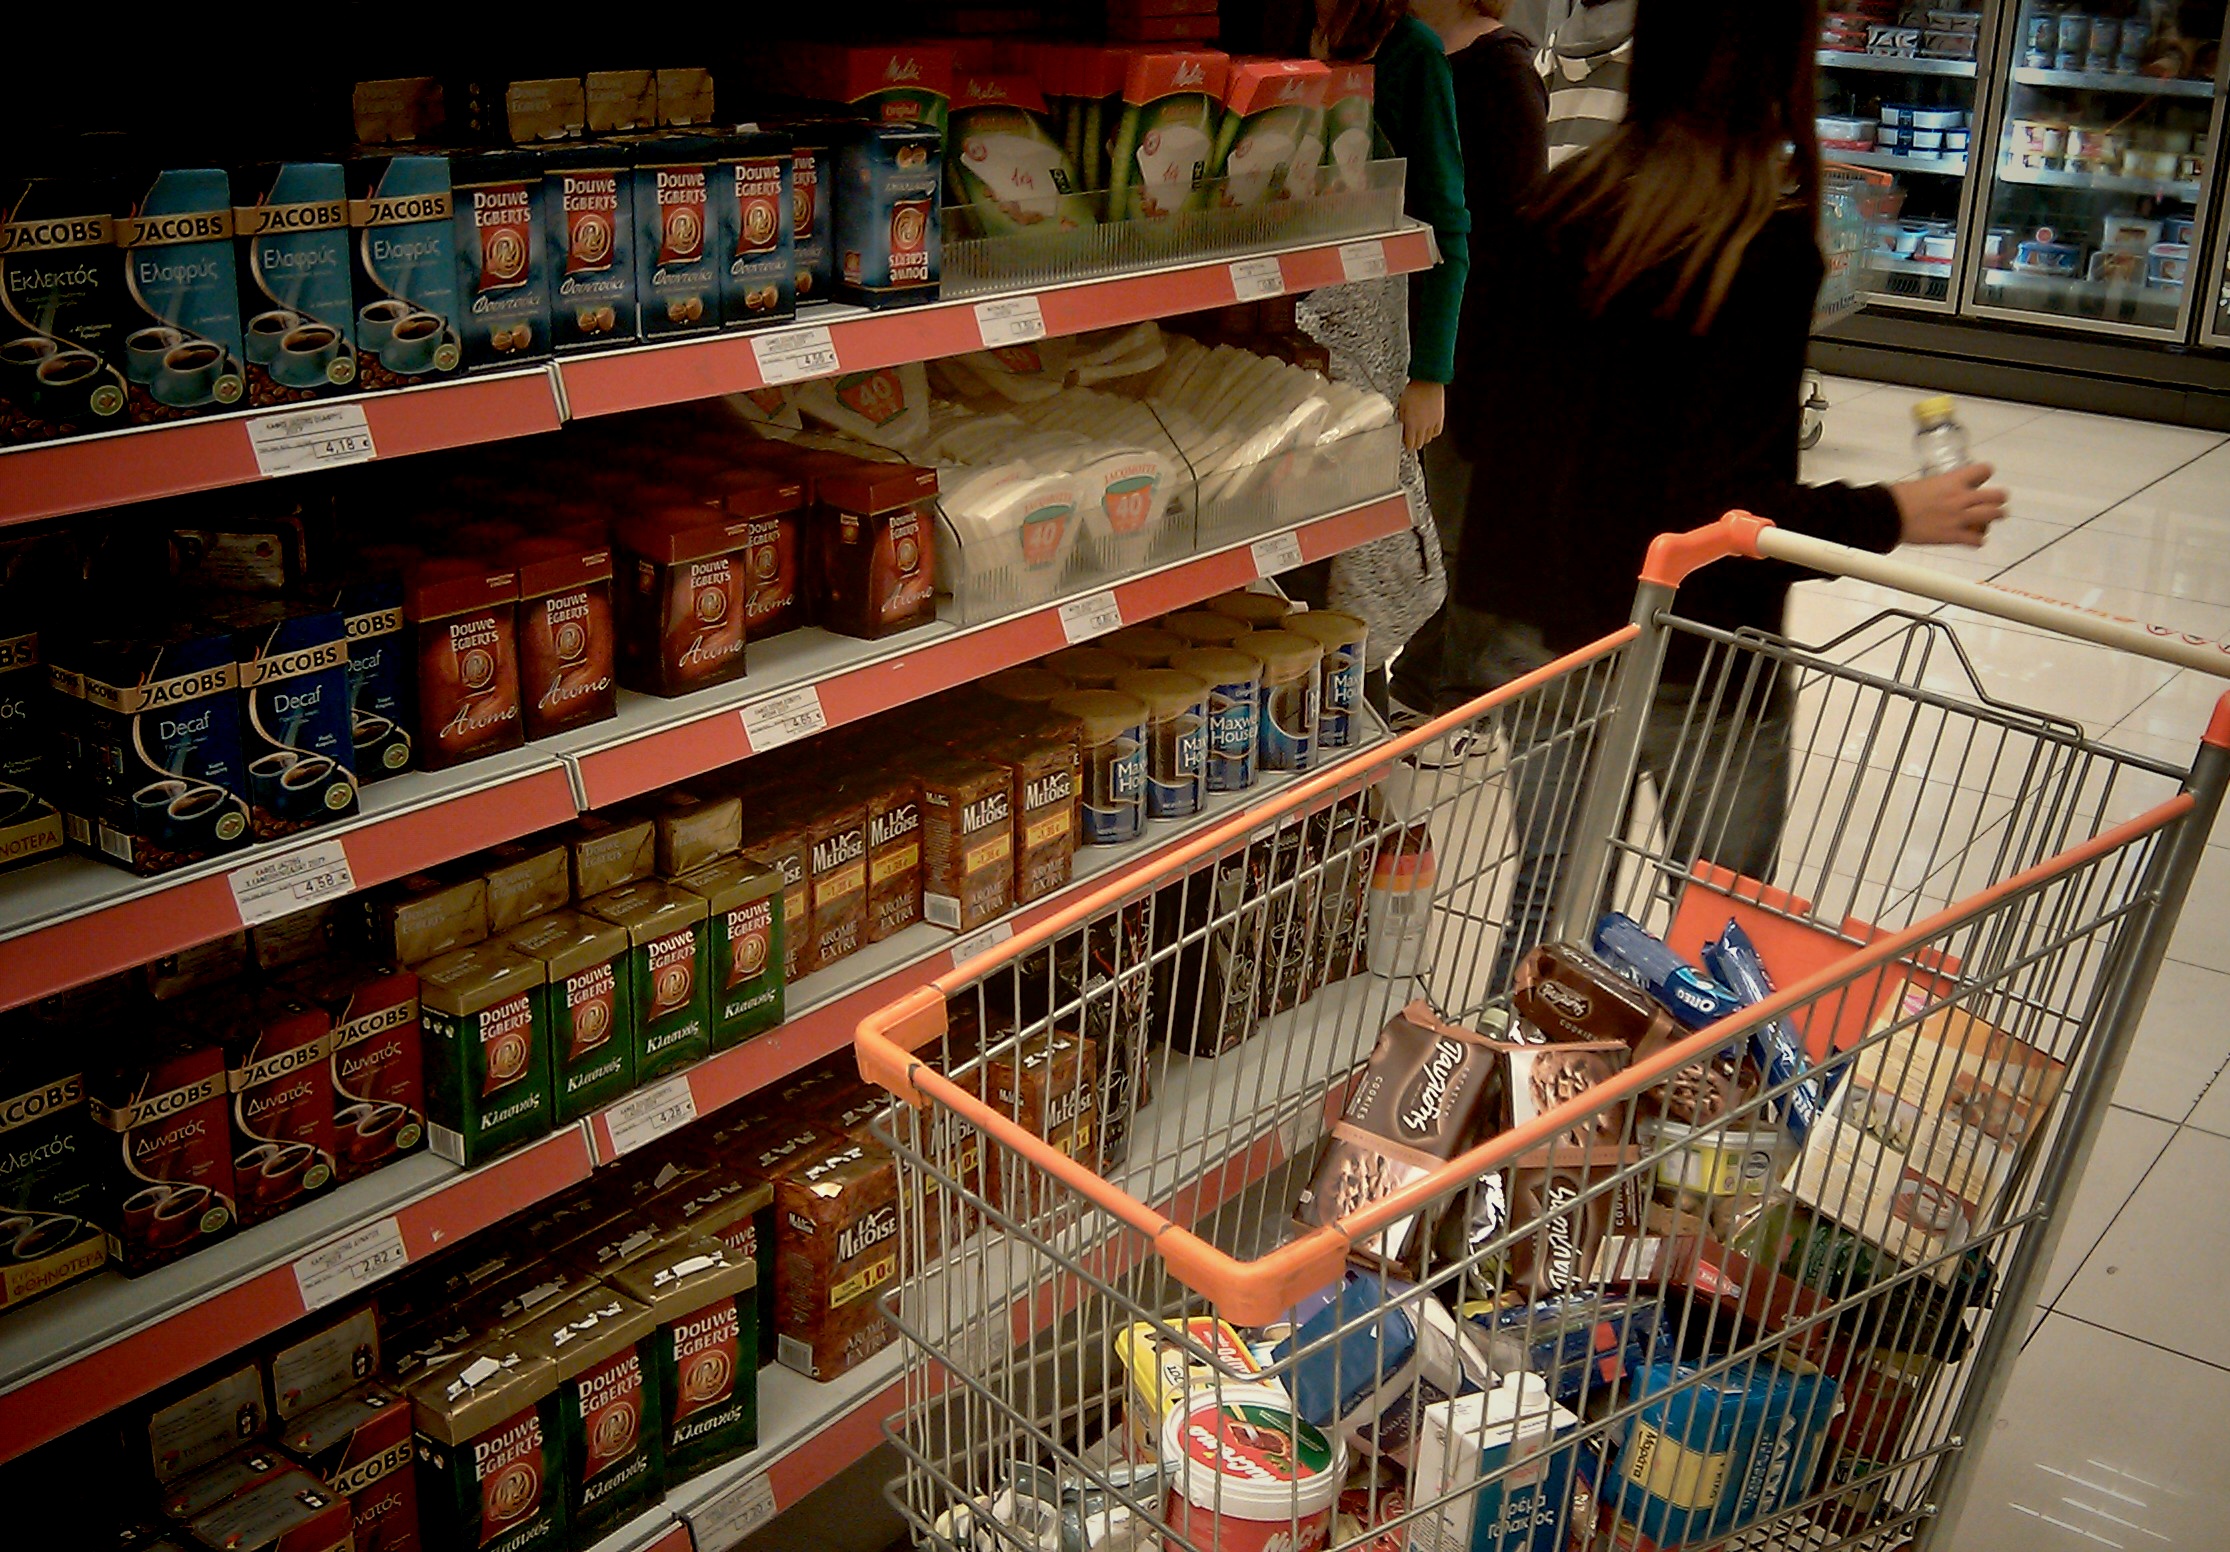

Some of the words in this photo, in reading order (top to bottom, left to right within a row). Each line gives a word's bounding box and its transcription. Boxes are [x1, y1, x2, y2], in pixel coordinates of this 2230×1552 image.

[563, 177, 617, 195] Douwe
[657, 171, 706, 188] Douwe
[735, 163, 781, 180] Douwe
[473, 190, 530, 210] Douwe
[563, 193, 618, 212] EGBERTS
[657, 188, 708, 206] EGBERTS
[735, 180, 782, 198] EGBERTS
[255, 205, 341, 233] JACOBS
[366, 199, 446, 225] JACOBS
[474, 206, 532, 228] EGBERTS
[1, 220, 103, 251] JACOBS
[129, 216, 223, 246] JACOBS
[10, 264, 99, 292] Εκλεκτός
[140, 258, 219, 285] Ελαφρύς
[690, 558, 730, 578] Douwe
[690, 571, 731, 588] EGBERTS
[546, 592, 588, 612] Douwe
[547, 605, 590, 626] EGBERTS
[450, 617, 496, 639] Douwe
[451, 630, 499, 653] EGBERTS
[252, 646, 338, 685] JACOBS
[135, 670, 227, 711] JACOBS
[274, 685, 323, 715] Decaf
[538, 672, 611, 710] Arome
[159, 709, 211, 741] Decaf
[440, 702, 520, 739] Arome
[1026, 782, 1071, 811] MELOISE
[871, 814, 919, 848] MELOISE
[963, 803, 1009, 834] MELOISE
[0, 830, 58, 858] ΝΟΤΕΡΑ
[813, 840, 863, 875] MELOISE
[727, 900, 771, 928] Douwe
[727, 914, 773, 941] EGBERTS
[648, 930, 695, 958] Douwe
[648, 945, 696, 972] EGBERTS
[566, 962, 613, 993] Douwe
[566, 978, 616, 1010] EGBERTS
[1675, 988, 1716, 1013] OREO
[335, 1005, 409, 1050] JACOBS
[479, 995, 530, 1029] Douwe
[479, 1009, 534, 1044] EGBERTS
[242, 1043, 320, 1089] JACOBS
[341, 1040, 403, 1077] Δυνατός
[130, 1080, 212, 1127] JACOBS
[247, 1079, 314, 1117] Δυνατός
[1356, 1076, 1384, 1121] COOKIES
[0, 1133, 76, 1173] κλεκτός
[135, 1119, 207, 1156] Δυνατός
[838, 1216, 898, 1264] MELOISE
[13, 1250, 105, 1296] ΦΘΗΝΟΤΕΡΑ
[673, 1304, 738, 1345] Douwe
[673, 1320, 741, 1363] EGBERTS
[579, 1355, 640, 1401] Douwe
[579, 1368, 644, 1419] EGBERTS
[475, 1415, 541, 1463] Douwe
[672, 1403, 744, 1446] Κλασικός
[475, 1430, 545, 1482] EGBERTS
[583, 1453, 649, 1507] Κλασικός
[353, 1493, 404, 1530] νατός
